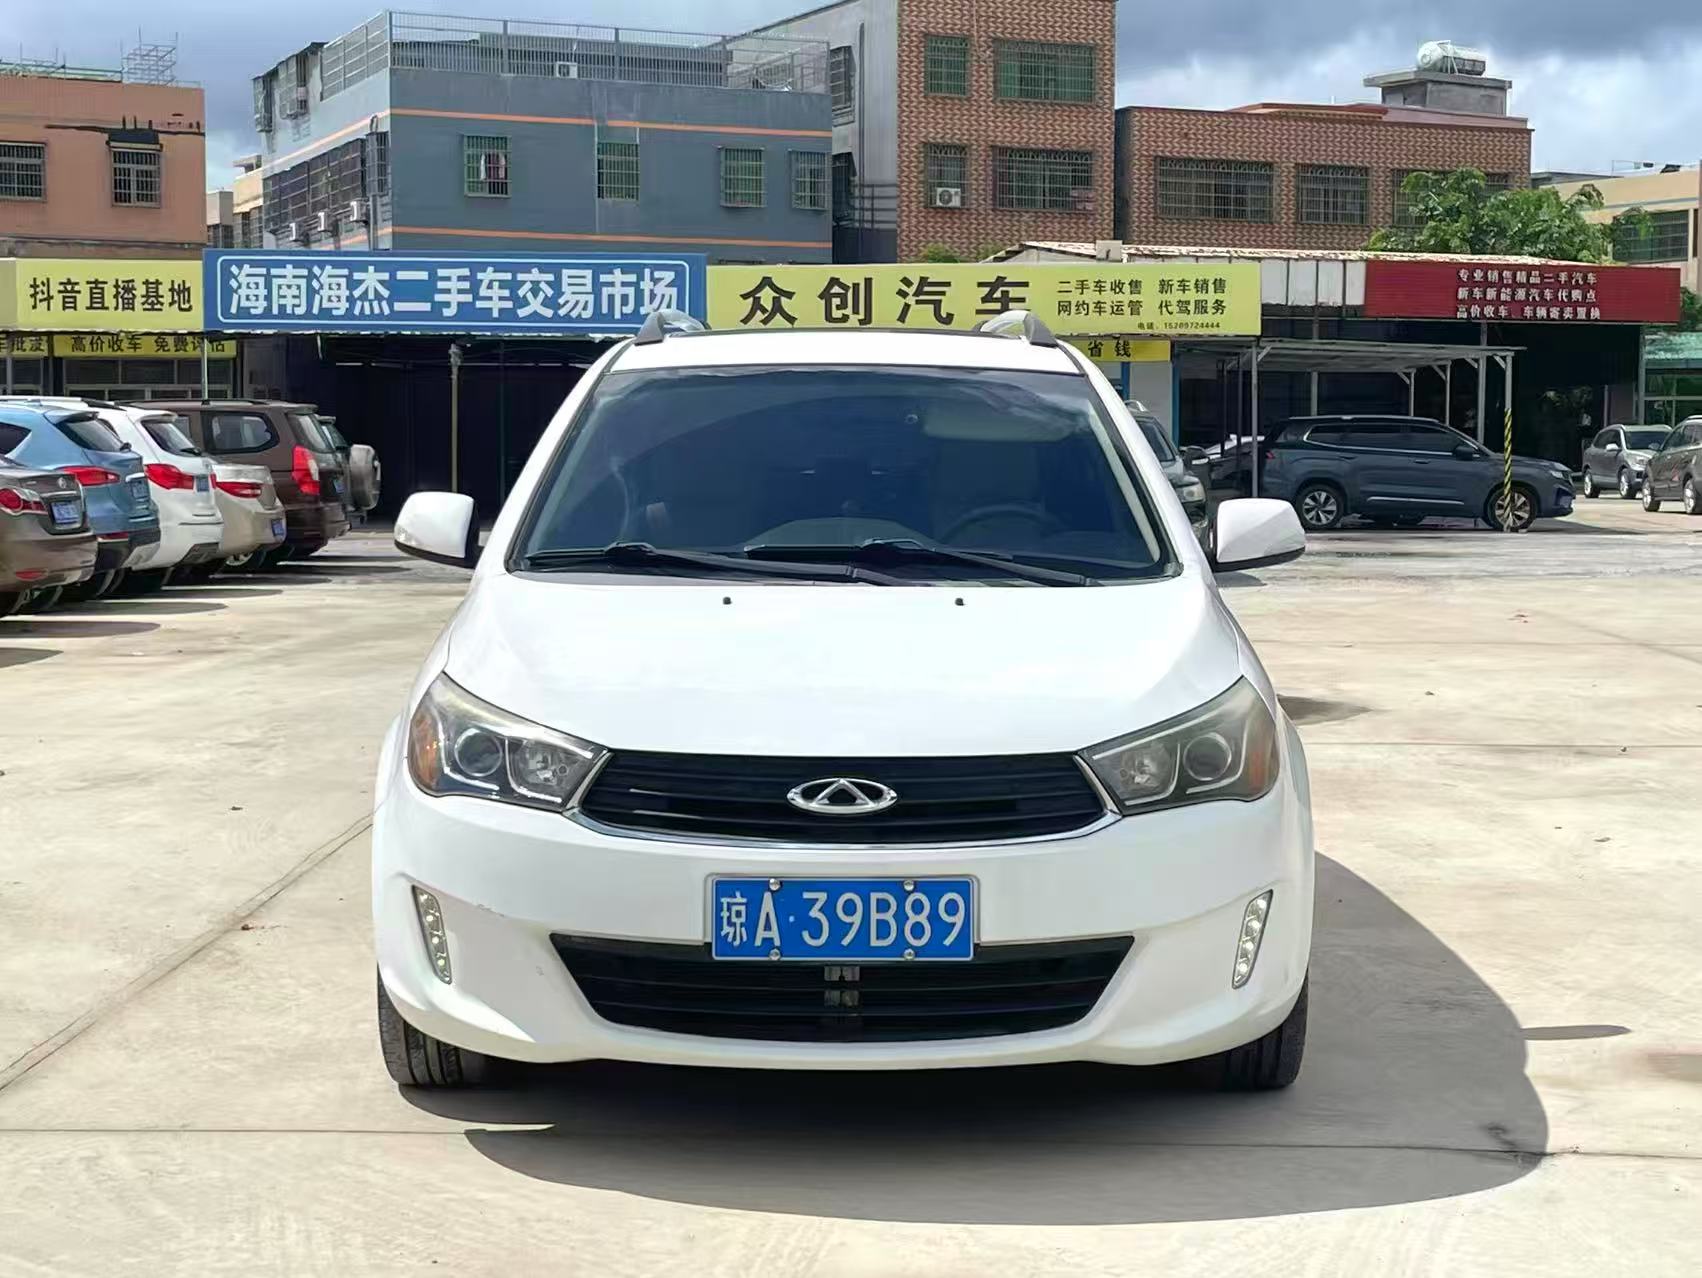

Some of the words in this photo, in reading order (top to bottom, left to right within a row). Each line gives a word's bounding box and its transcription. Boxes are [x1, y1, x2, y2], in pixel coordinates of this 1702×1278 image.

[1057, 278, 1143, 296] 二手车收售
[1158, 277, 1227, 295] 新车销售
[1458, 268, 1598, 286] 专业销售精品二手汽车
[29, 277, 193, 312] 抖音直播基地
[228, 264, 677, 320] 海南海杰二手车交易市场
[739, 275, 1031, 326] 众创汽车
[1457, 286, 1597, 303] 新车新能源汽车代购点
[1158, 299, 1227, 316] 代驾服务
[1456, 304, 1509, 319] 高价收车
[1523, 305, 1601, 320] 车辆寄卖置换
[71, 335, 142, 353] 高价收车
[154, 335, 226, 353] 免费评估
[1087, 339, 1132, 358] 省钱
[720, 890, 966, 947] 琼A·39B89
